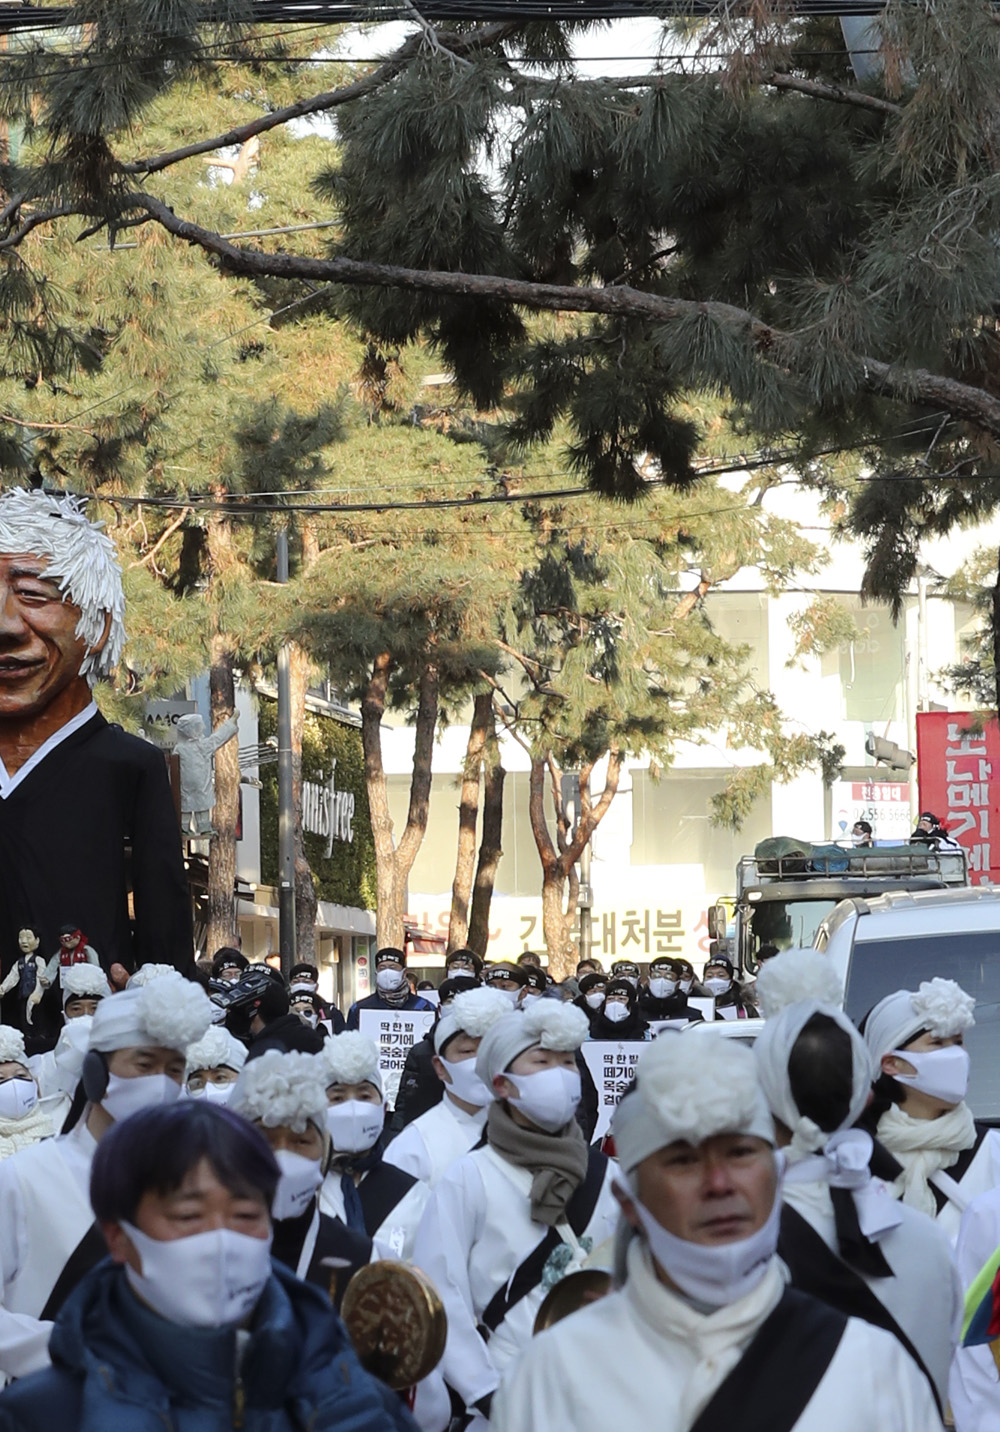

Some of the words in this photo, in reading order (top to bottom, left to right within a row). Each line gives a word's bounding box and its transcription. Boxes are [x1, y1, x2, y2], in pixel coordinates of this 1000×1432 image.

[302, 758, 355, 859] nnisfree
[380, 1021, 390, 1032] 딱
[392, 1022, 402, 1032] 한
[380, 1033, 414, 1045] 떼기에
[603, 1054, 614, 1065] 딱
[616, 1054, 627, 1065] 한
